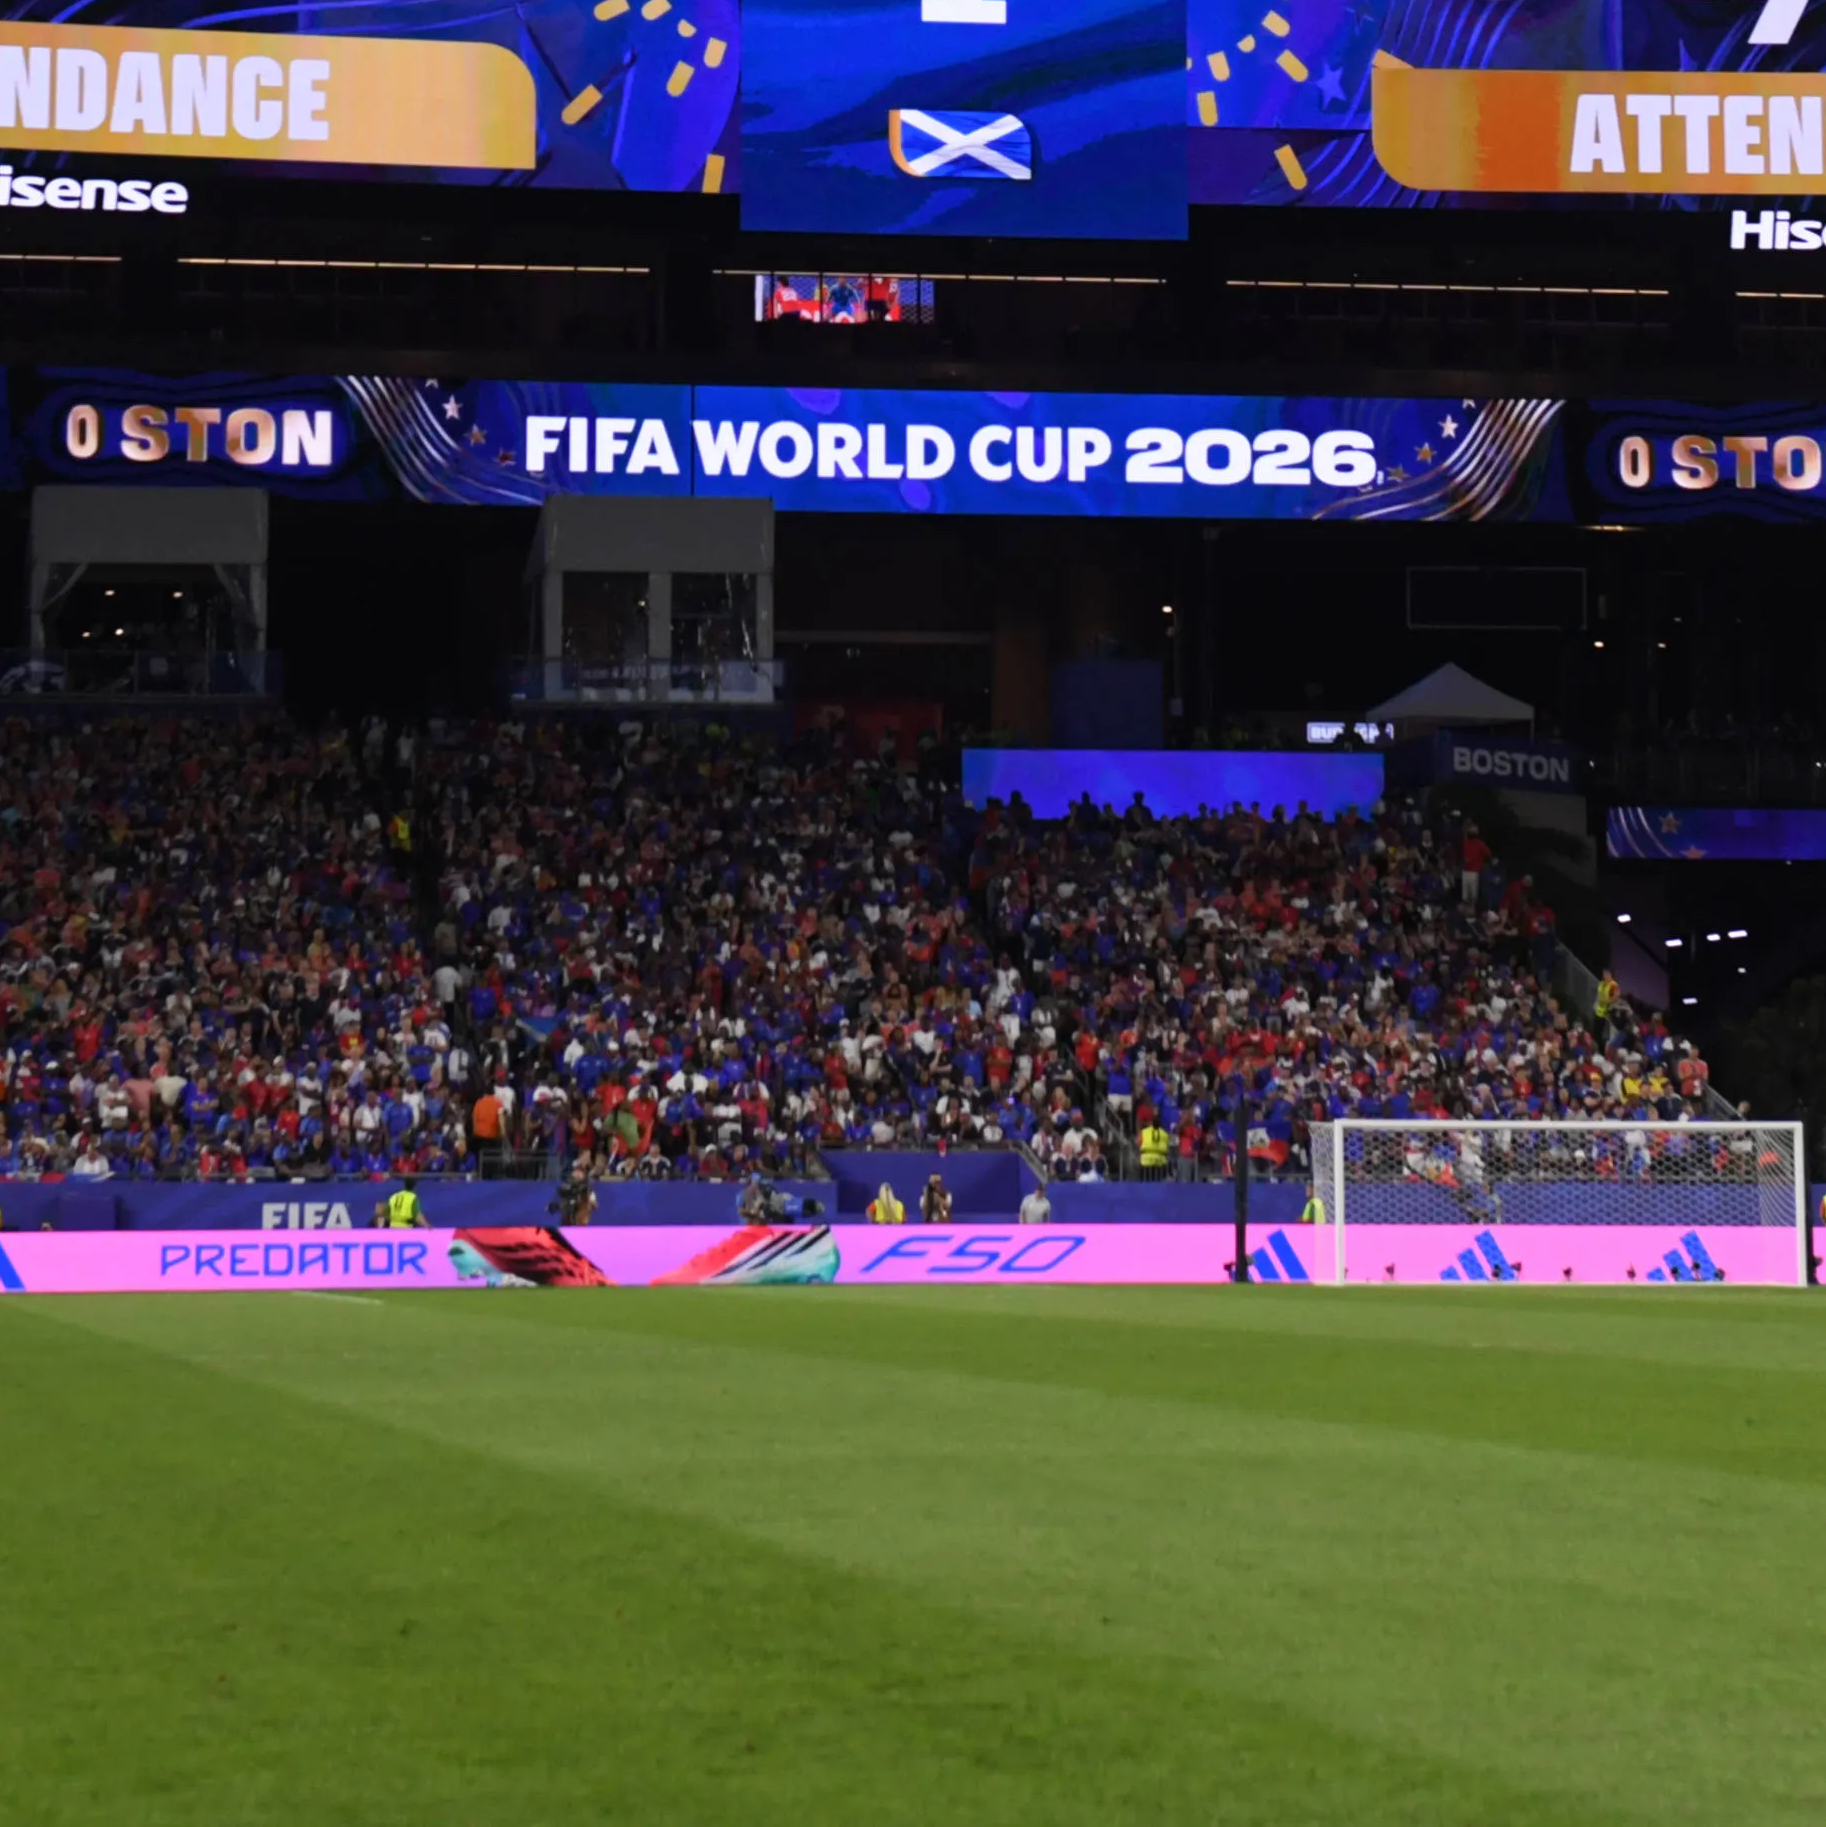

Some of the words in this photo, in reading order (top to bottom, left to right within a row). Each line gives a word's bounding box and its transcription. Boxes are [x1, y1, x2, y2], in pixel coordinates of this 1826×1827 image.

[526, 415, 680, 475] FIFA
[692, 420, 955, 480] WORLD
[969, 425, 1112, 482] CUP
[1125, 427, 1377, 487] 2026
[1453, 746, 1570, 783] BOSTON
[261, 1202, 353, 1230] FIFA
[160, 1242, 428, 1276] PREDATOR
[859, 1235, 1086, 1273] F50
